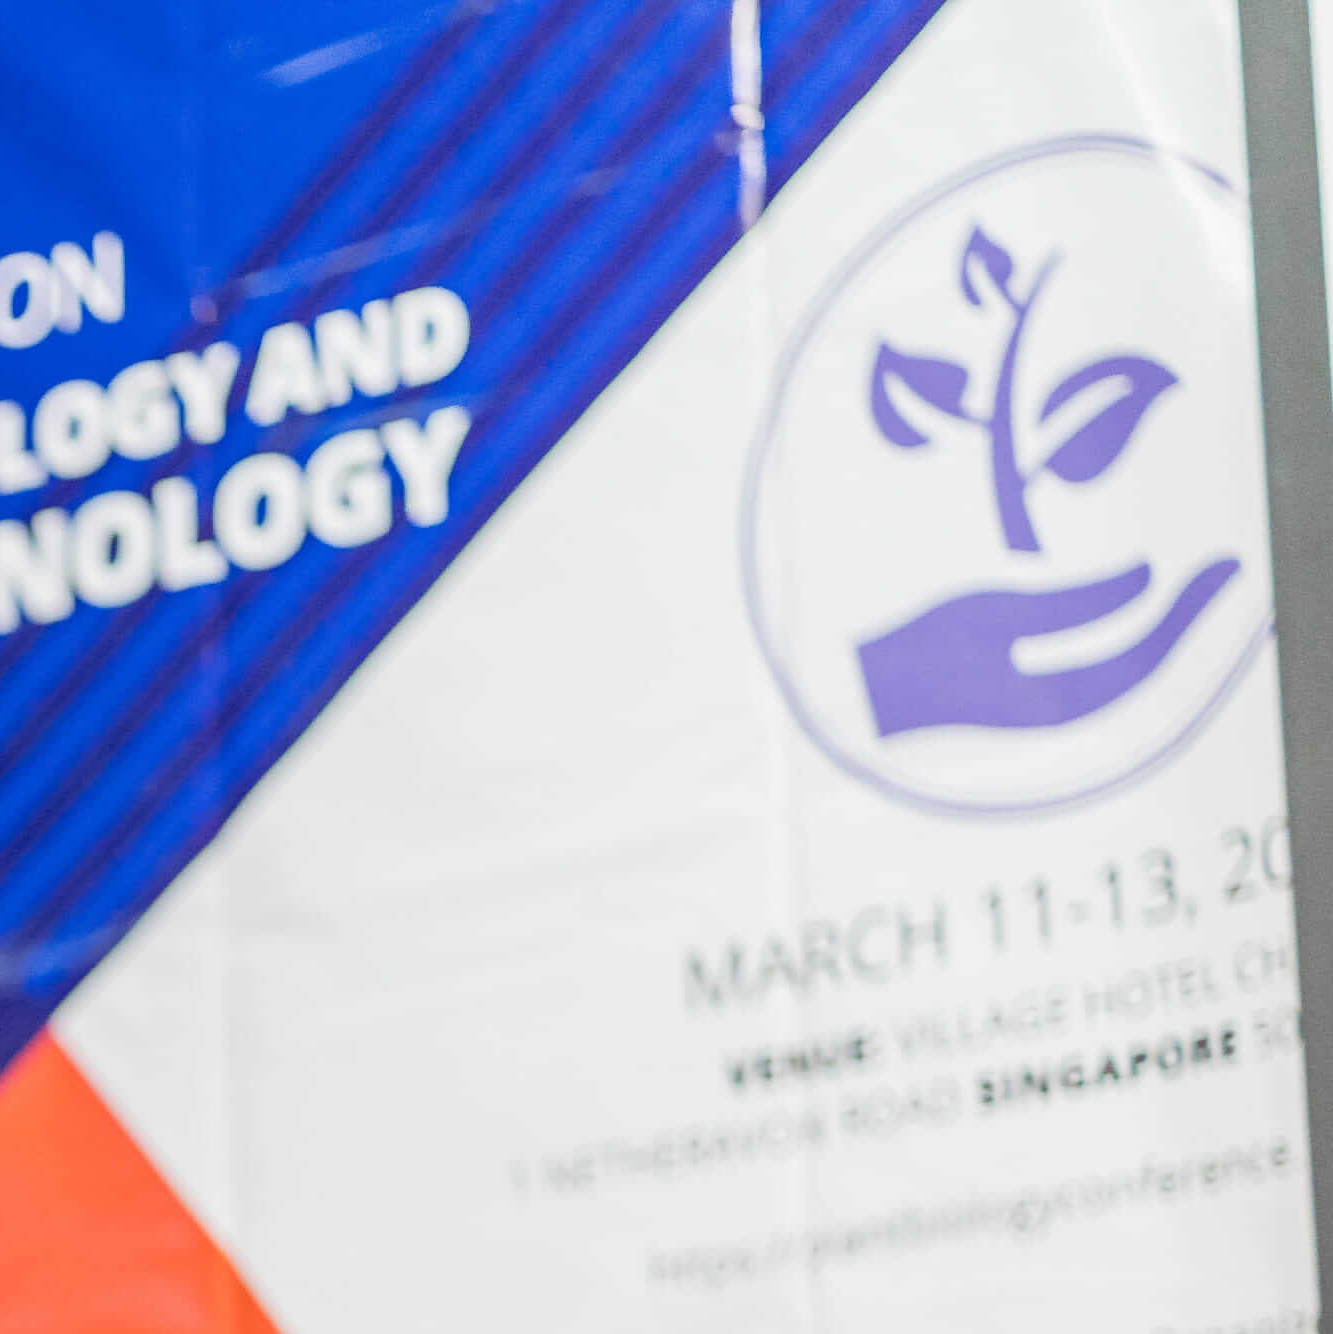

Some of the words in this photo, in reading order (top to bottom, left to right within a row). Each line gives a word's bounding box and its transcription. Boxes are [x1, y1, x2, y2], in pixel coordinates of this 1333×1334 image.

[243, 285, 473, 427] AND
[680, 898, 951, 1014] MARCH
[982, 845, 1200, 952] 11-13,
[895, 988, 1070, 1055] VILLAGE
[1083, 958, 1221, 1026] HOTEL
[974, 1018, 1239, 1112] SINGAPORE
